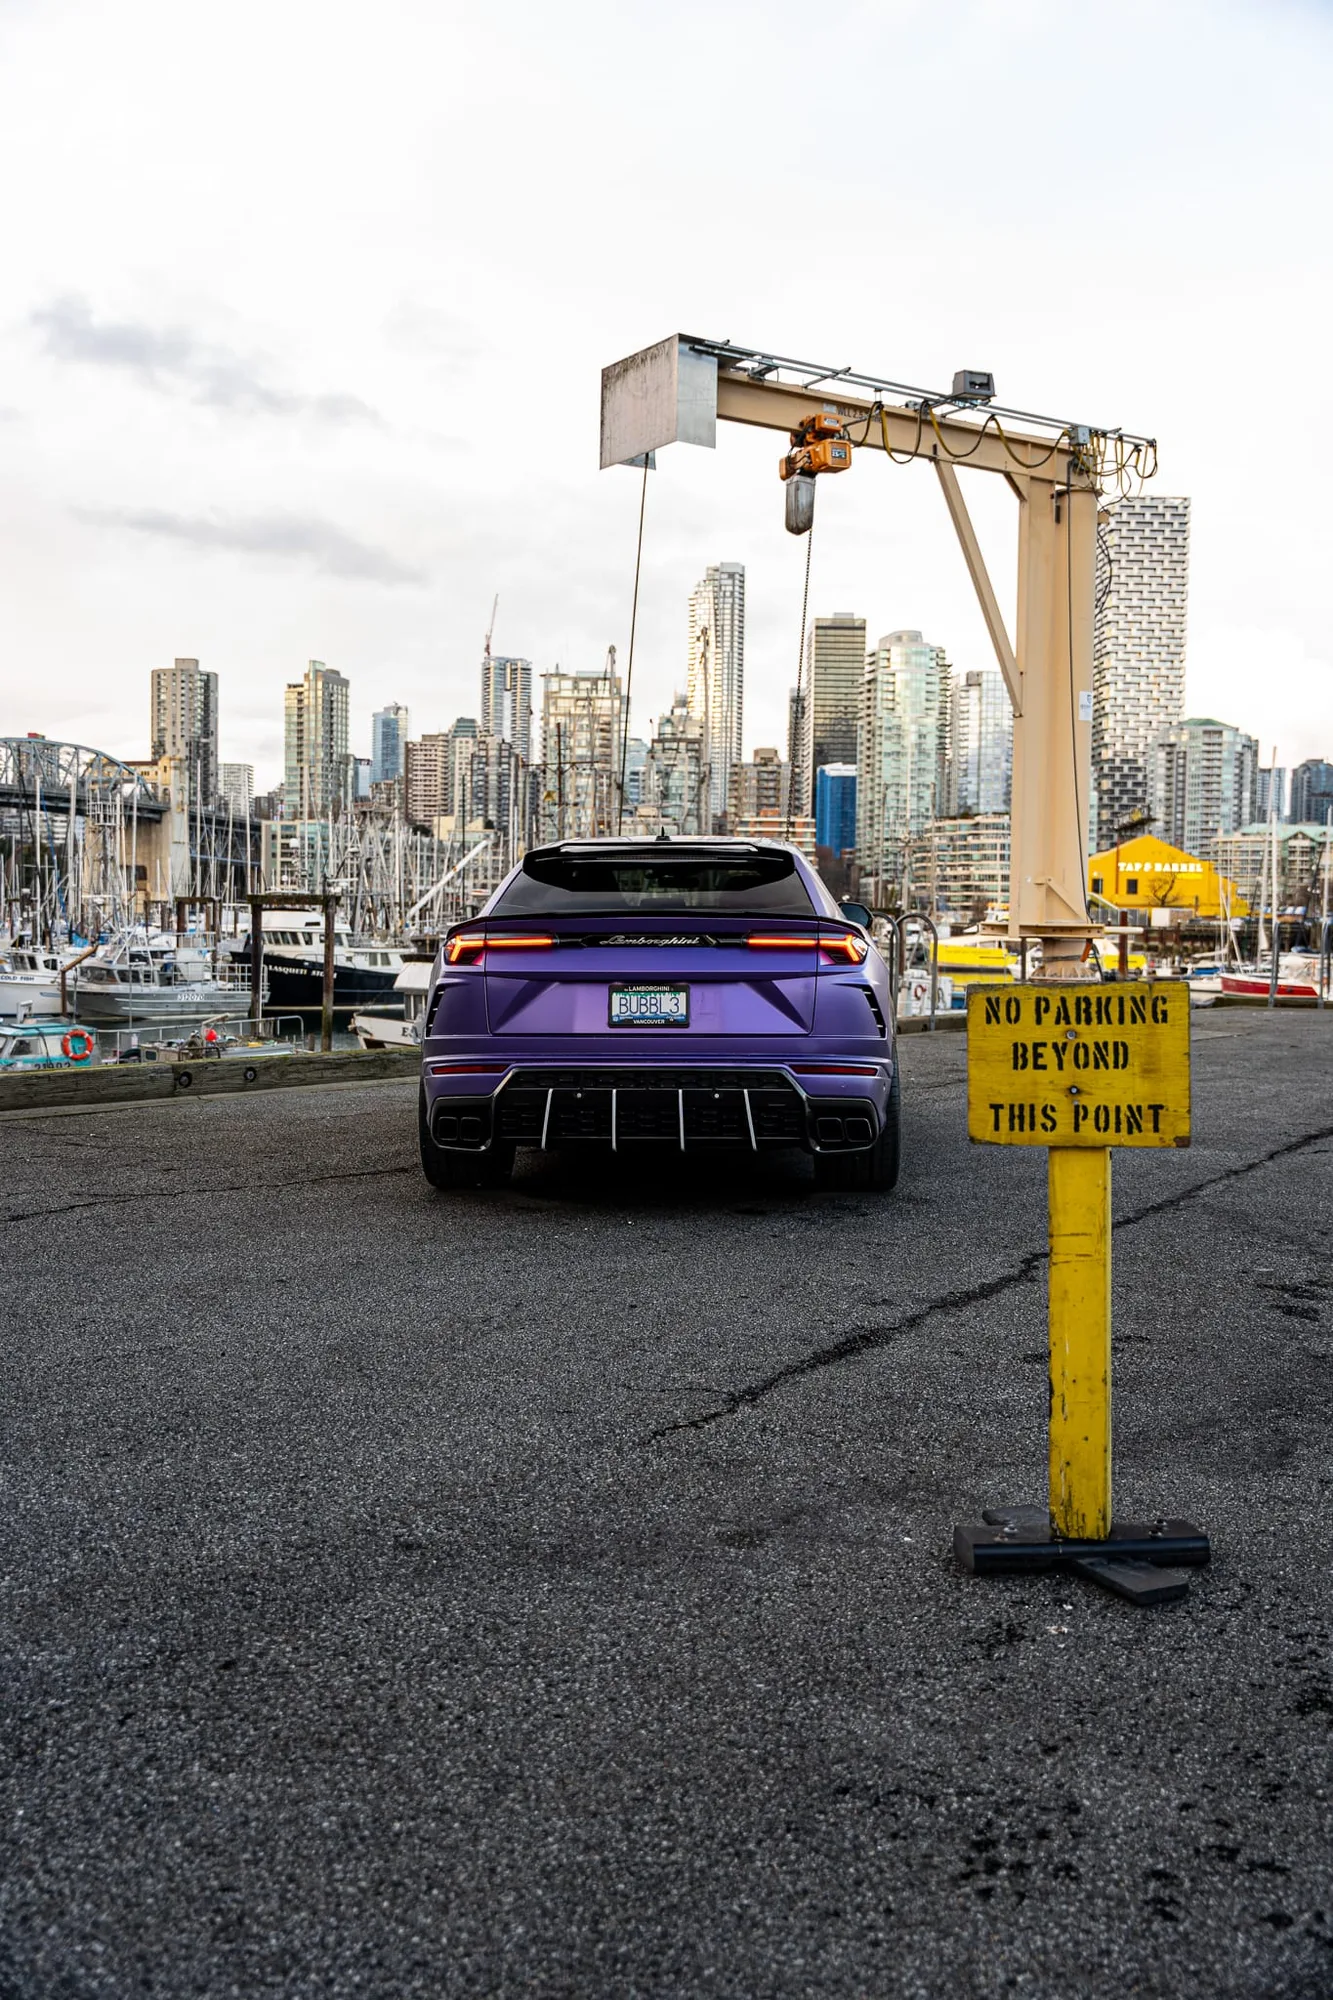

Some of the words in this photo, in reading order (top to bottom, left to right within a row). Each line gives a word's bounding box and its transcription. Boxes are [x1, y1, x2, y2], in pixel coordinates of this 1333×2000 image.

[1118, 862, 1142, 872] TAP
[1143, 862, 1152, 872] &
[1154, 863, 1203, 873] BARREL
[599, 934, 700, 947] Lamborghini
[985, 996, 1021, 1025] NO
[1034, 996, 1168, 1026] PARKING
[1012, 1041, 1129, 1071] BEYOND
[989, 1103, 1057, 1133] THIS
[1073, 1104, 1165, 1135] POINT
